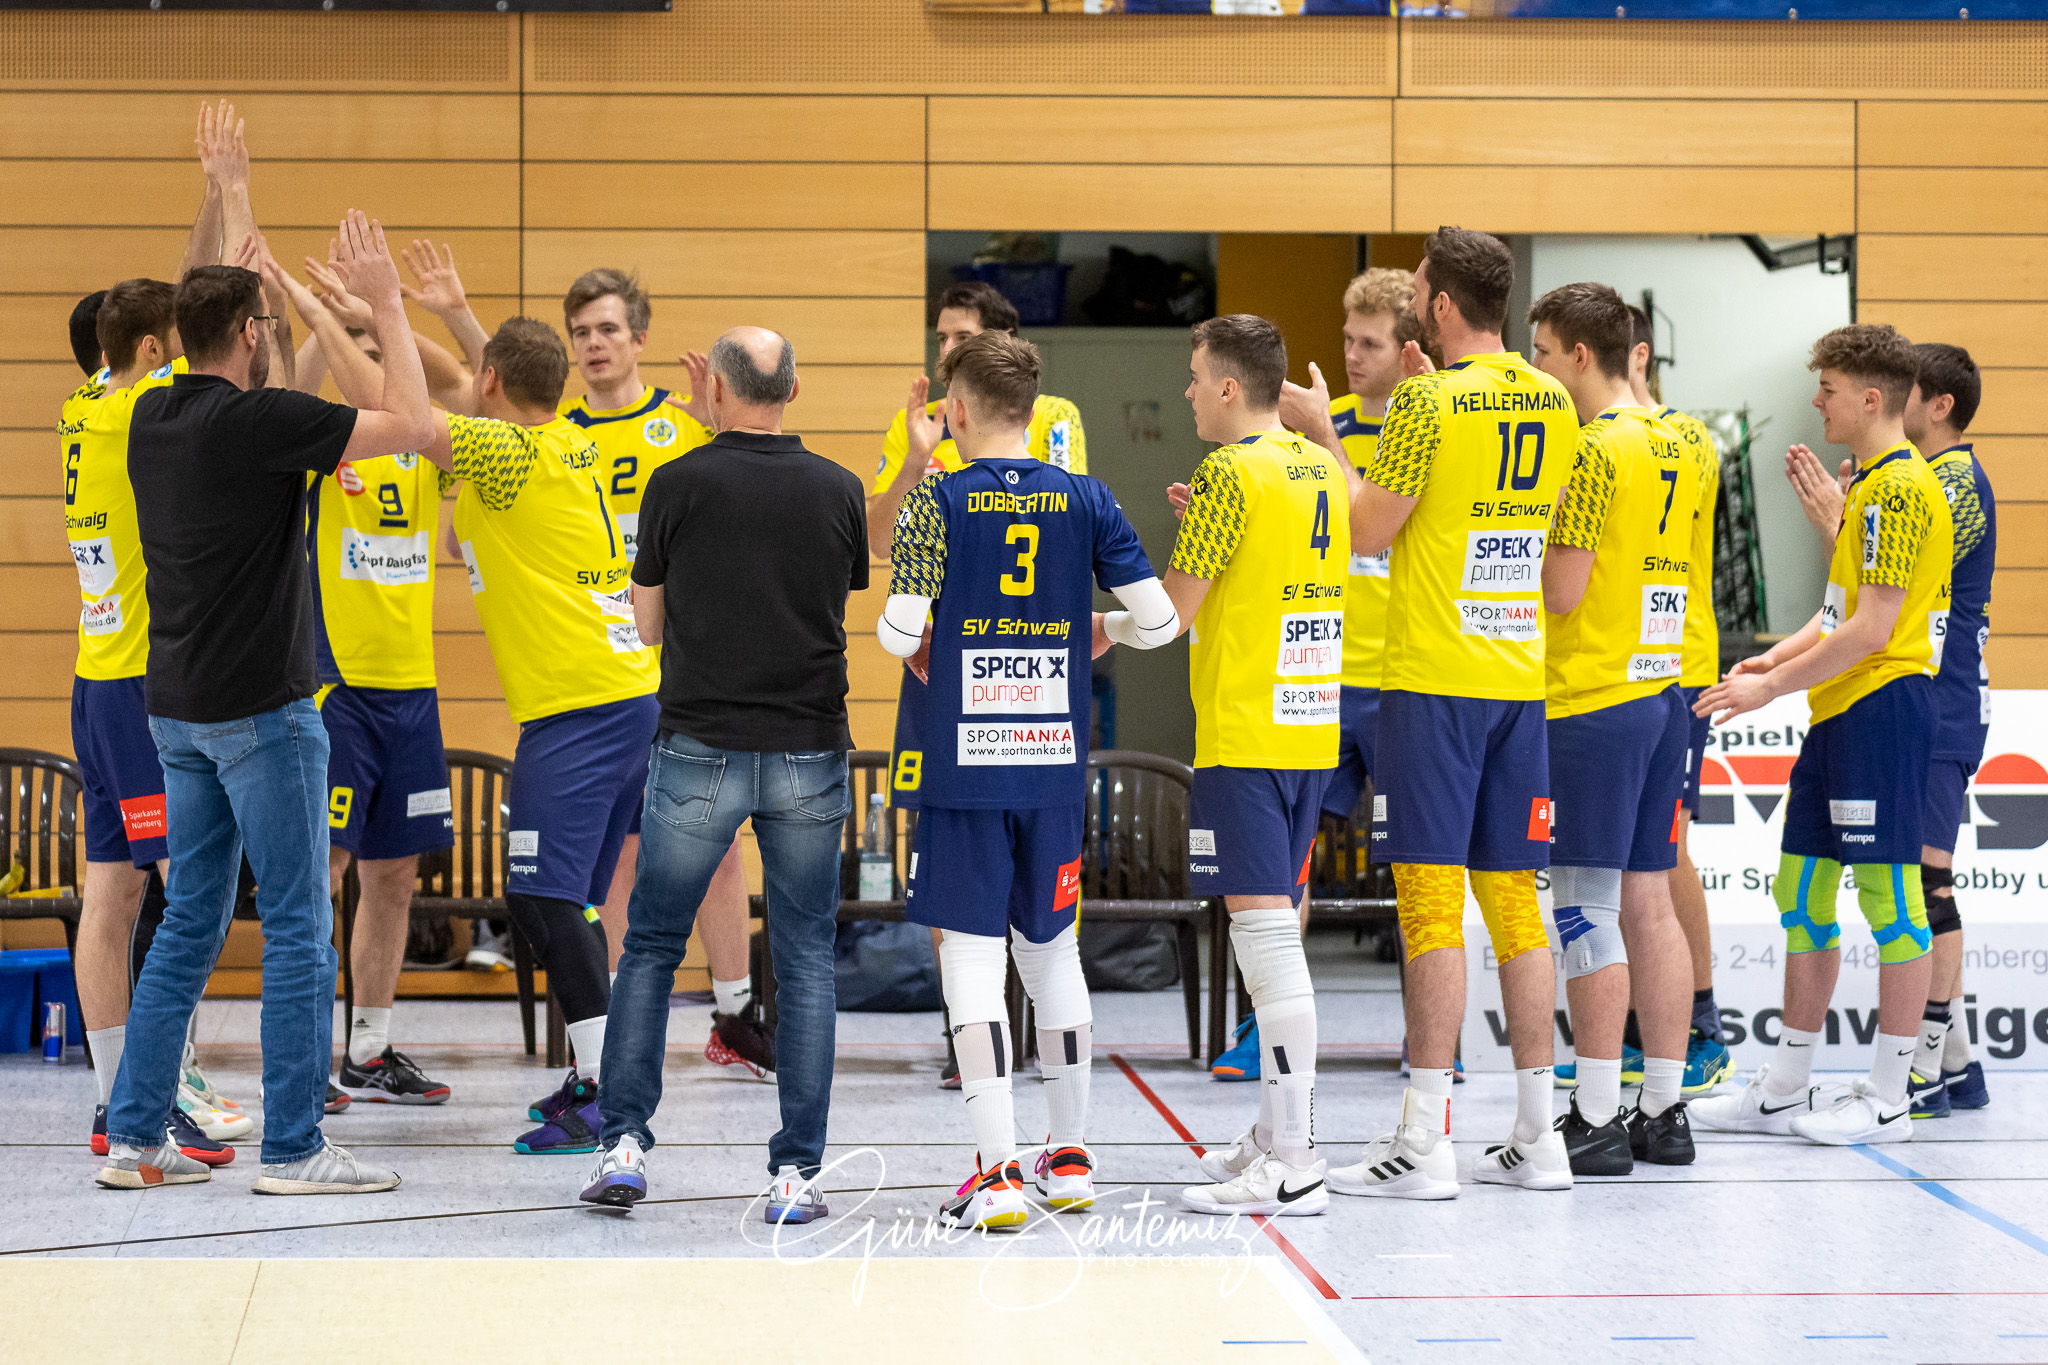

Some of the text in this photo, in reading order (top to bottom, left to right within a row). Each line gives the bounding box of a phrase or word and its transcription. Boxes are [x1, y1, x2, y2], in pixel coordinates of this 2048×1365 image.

[1452, 391, 1569, 414] KELLERMANN
[1496, 421, 1545, 491] 10
[66, 443, 81, 505] 6
[611, 455, 638, 496] 2
[378, 482, 404, 516] 9
[967, 491, 1068, 514] DOBBERTIN
[1470, 501, 1495, 517] SV
[1659, 469, 1678, 535] 7
[1310, 490, 1330, 560] 4
[1475, 537, 1532, 559] SPECK
[1000, 524, 1040, 596] 3
[576, 571, 601, 585] SV
[1282, 583, 1299, 601] SV
[962, 618, 1071, 640] SV Schwaig
[1286, 619, 1330, 642] SPECK
[972, 656, 1042, 679] SPECK
[972, 684, 1044, 706] pumpen
[967, 729, 1072, 743] SPORTNANKA
[967, 743, 1072, 759] www.sportnanka.de
[894, 750, 923, 791] 8
[129, 809, 162, 820] Sparkasse
[328, 786, 354, 829] 9
[131, 820, 162, 829] Nürnberg
[1841, 832, 1875, 844] Kempa
[1190, 863, 1219, 875] Kempa
